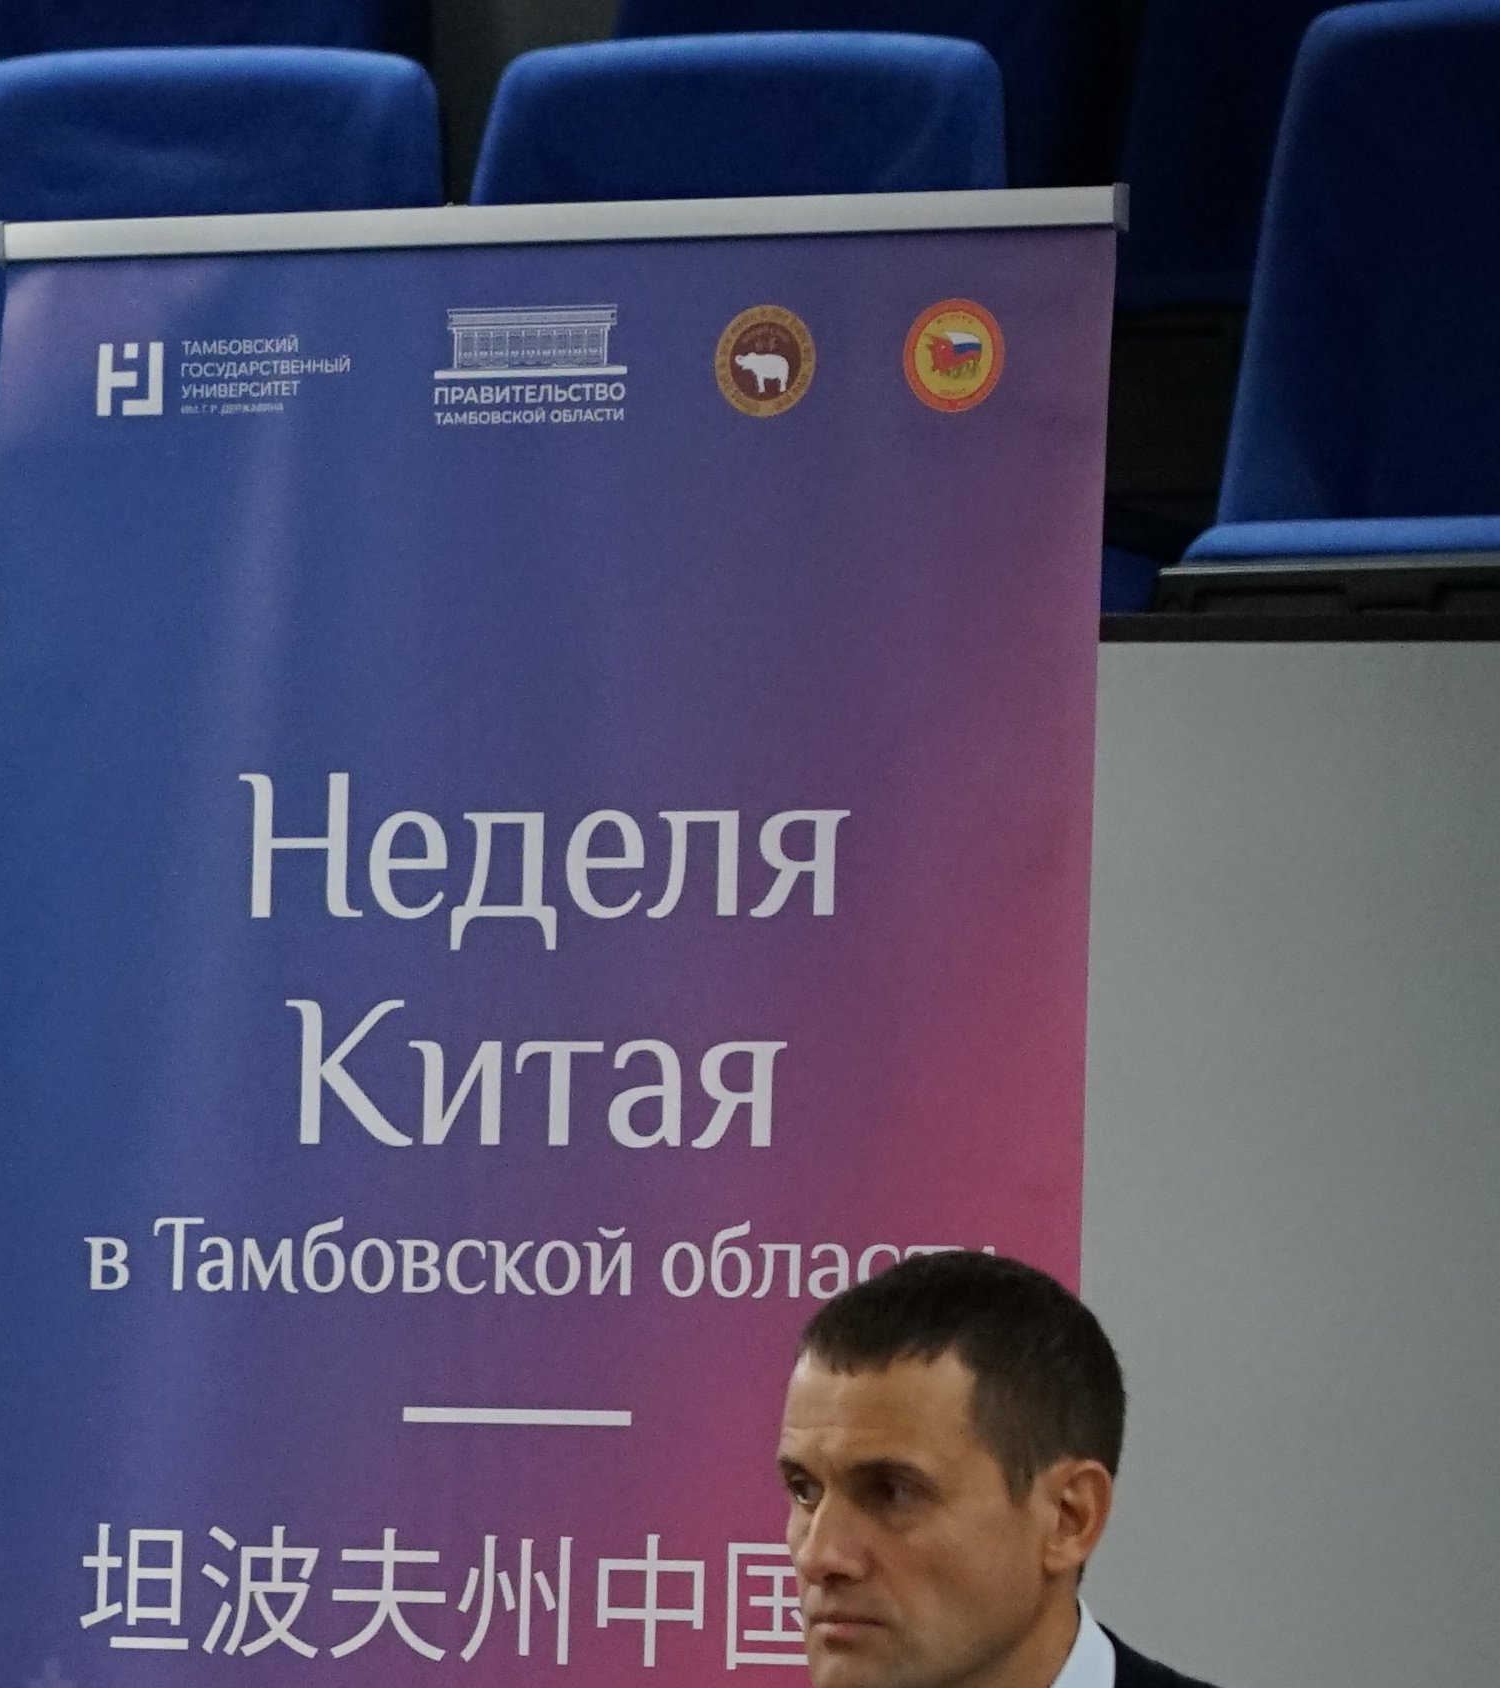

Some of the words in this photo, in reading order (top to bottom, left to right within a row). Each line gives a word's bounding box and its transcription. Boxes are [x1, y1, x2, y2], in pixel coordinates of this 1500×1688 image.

[181, 334, 299, 356] ТАМБОВСКИЙ
[181, 355, 351, 378] ГОСУДАРСТВЕННЫЙ
[181, 380, 300, 399] УНИВЕРСИТЕТ
[434, 382, 626, 405] ПРАВИТЕЛЬСТВО
[435, 408, 546, 425] ТАМБОВСКОЙ
[550, 408, 625, 424] ОБЛАСТИ
[238, 772, 851, 951] Неделя
[286, 999, 788, 1149] Китая
[84, 1235, 129, 1292] в
[154, 1216, 632, 1297] Тамбовской
[661, 1220, 996, 1300] облас
